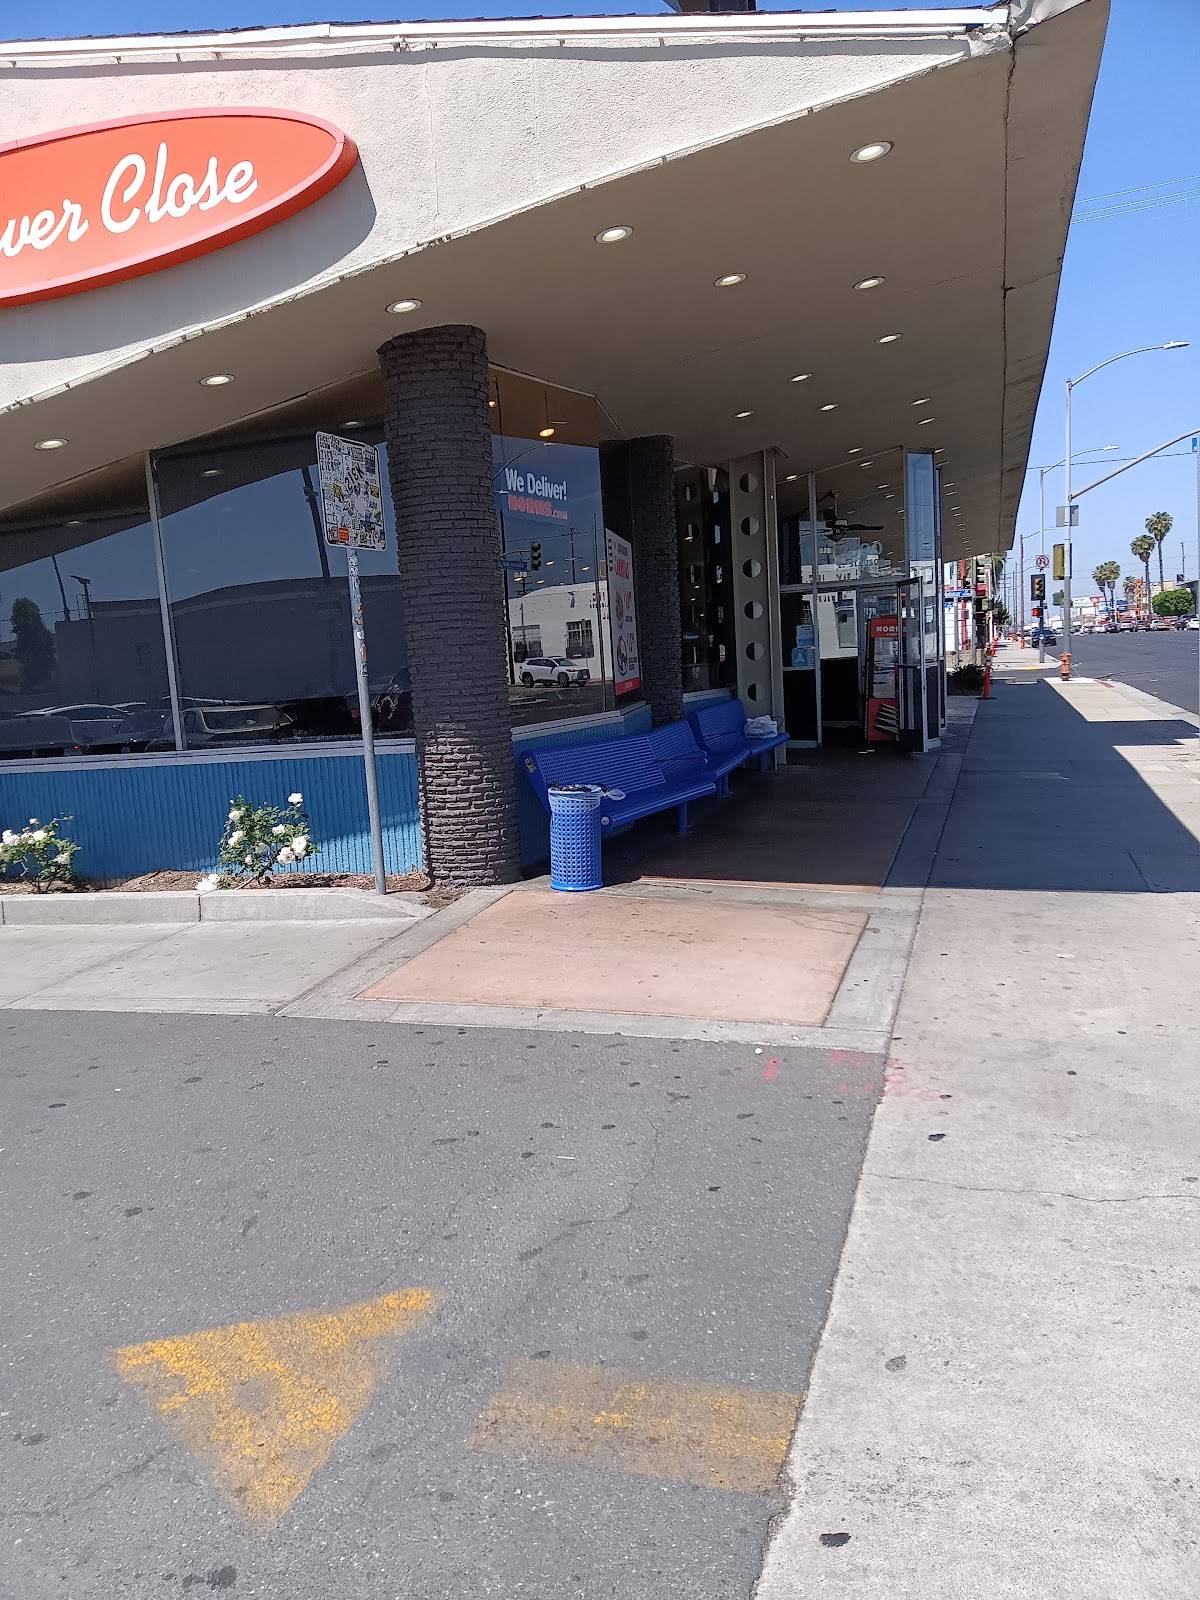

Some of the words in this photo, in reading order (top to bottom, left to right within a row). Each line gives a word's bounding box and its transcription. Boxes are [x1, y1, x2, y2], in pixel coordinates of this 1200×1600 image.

[0, 198, 89, 258] ver
[101, 142, 258, 234] Close
[505, 467, 525, 492] We
[526, 472, 567, 501] Deliver!
